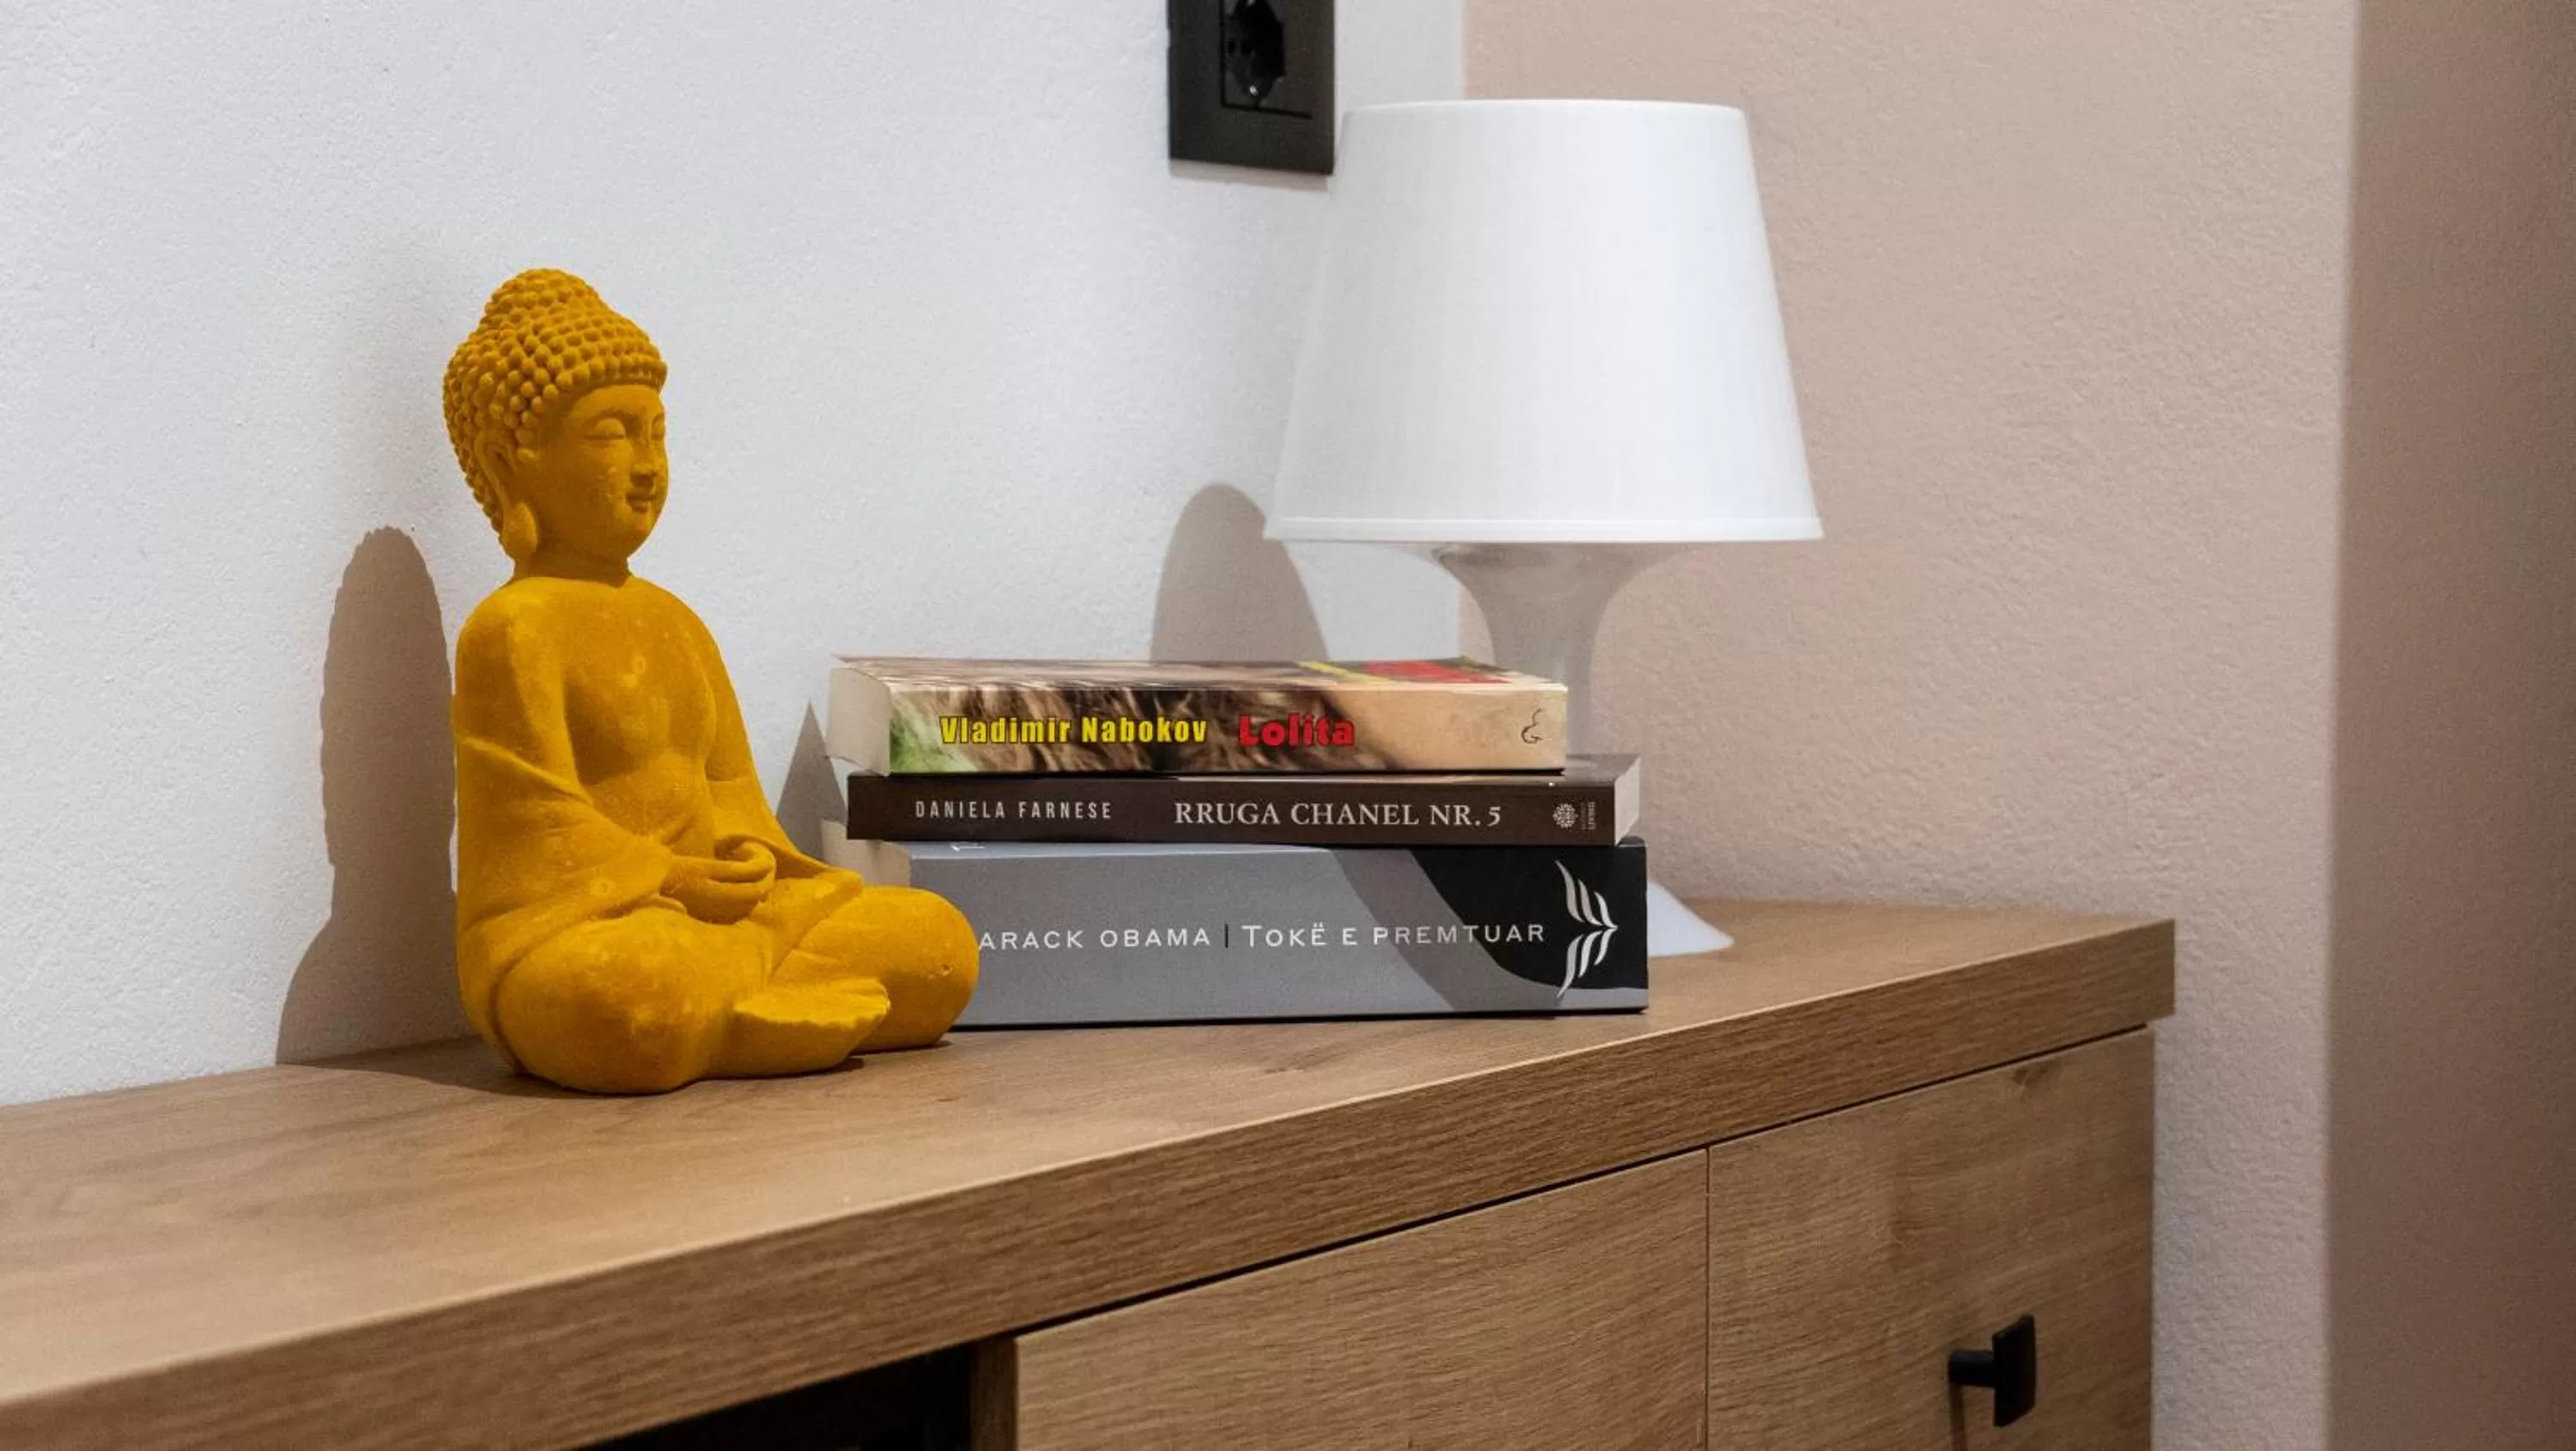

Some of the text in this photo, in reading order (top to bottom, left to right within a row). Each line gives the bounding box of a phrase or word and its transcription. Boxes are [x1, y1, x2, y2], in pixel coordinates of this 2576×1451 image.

[939, 713, 1354, 747] Vladimir Nabokov Lolita
[914, 800, 1502, 827] DANIELA FARNESE RRUGA CHANEL NR. 5
[977, 921, 1545, 950] ARACK OBAMA TOKË E PREMTUAR
